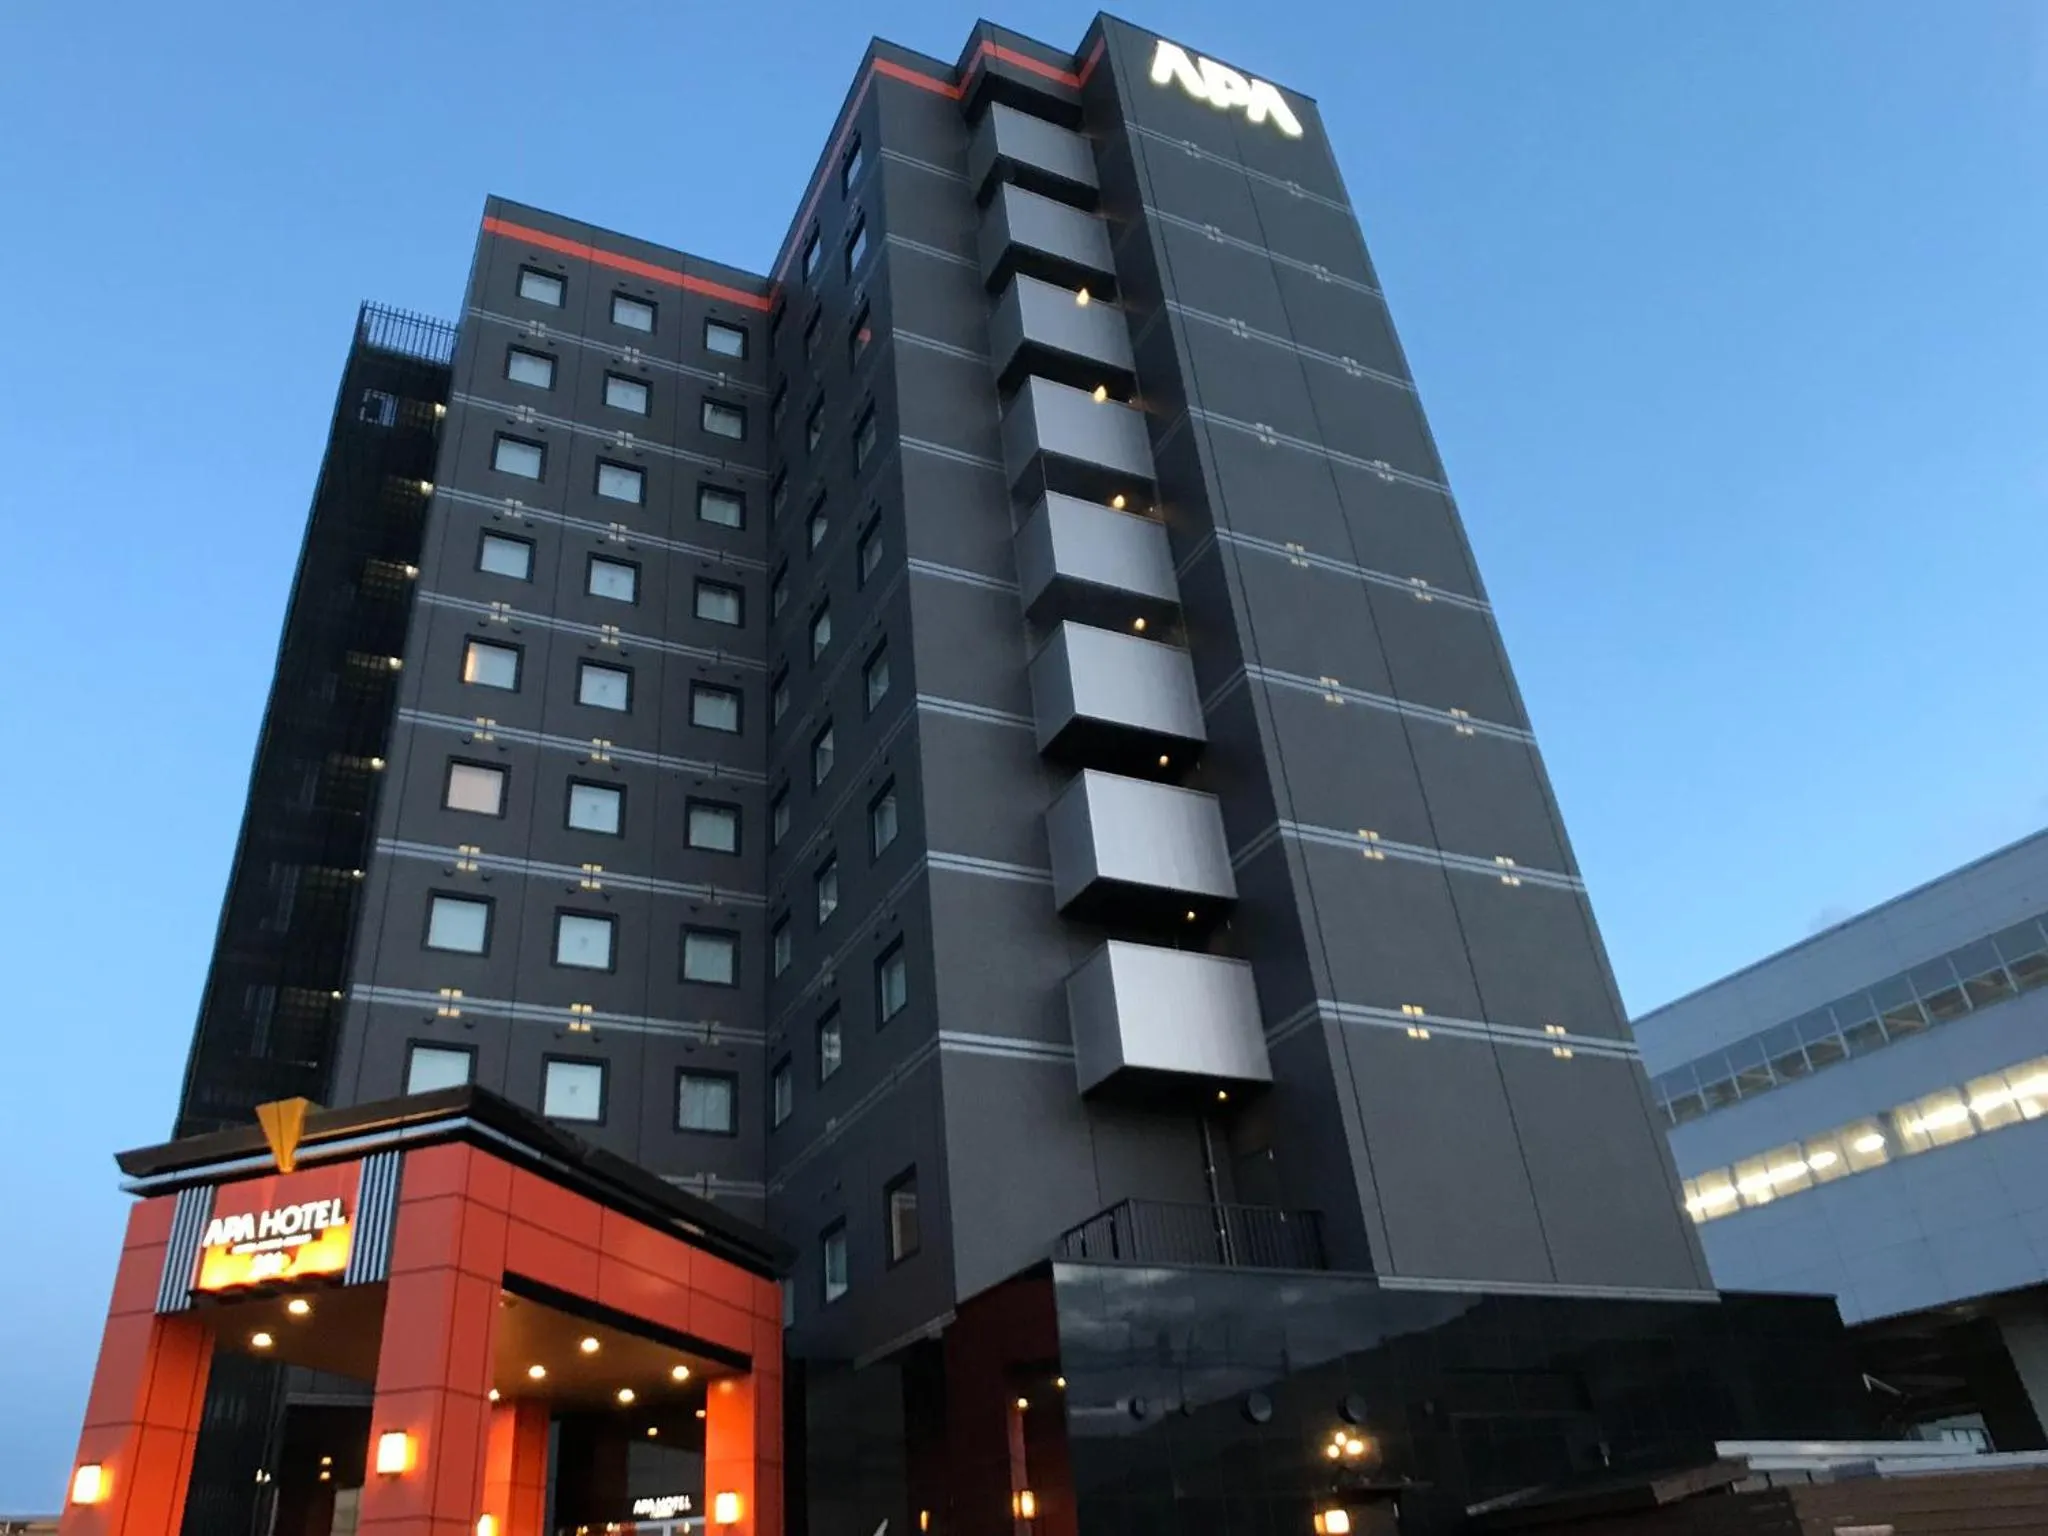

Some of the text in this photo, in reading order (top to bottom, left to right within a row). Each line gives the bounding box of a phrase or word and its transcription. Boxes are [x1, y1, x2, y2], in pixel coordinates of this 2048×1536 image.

[1151, 39, 1304, 138] APA
[202, 1212, 255, 1248] APA
[258, 1197, 346, 1239] HOTEL
